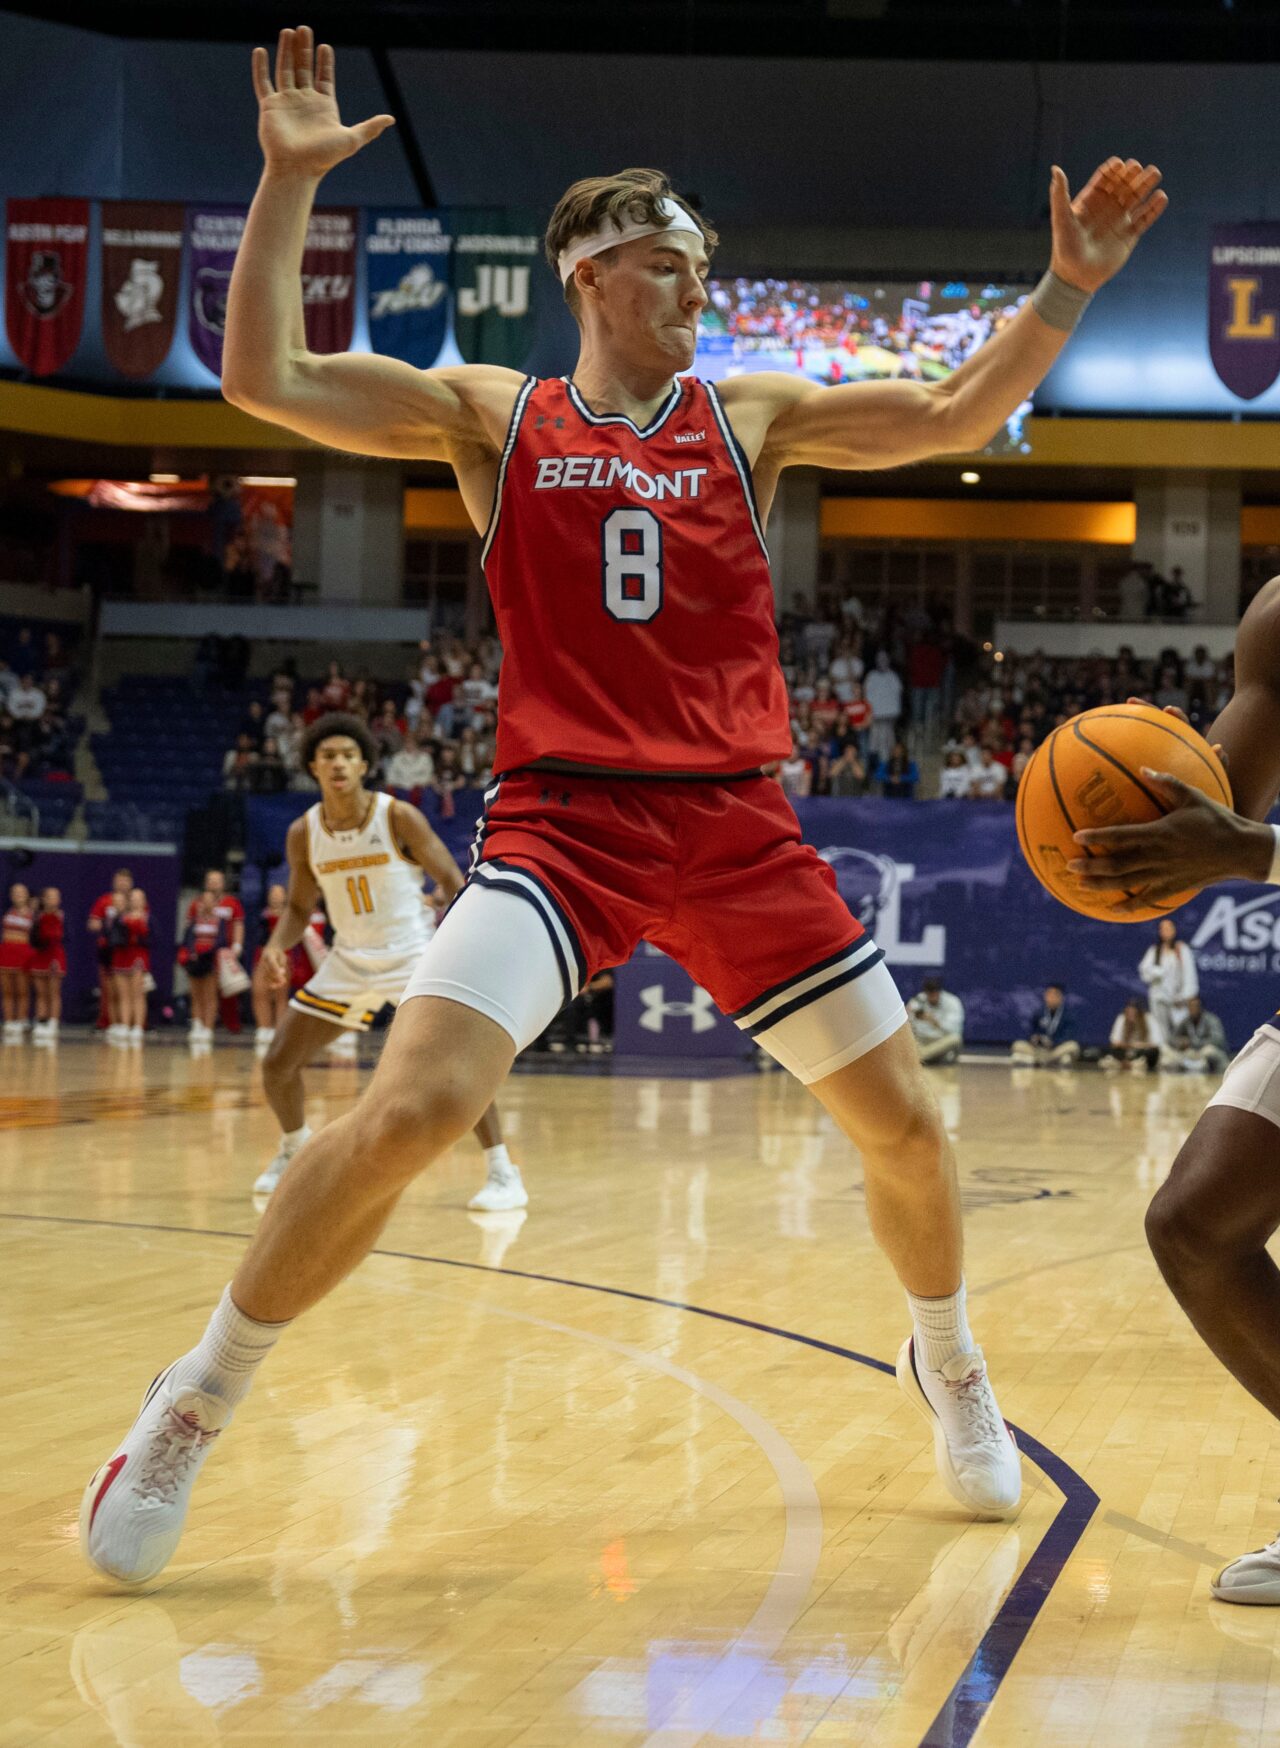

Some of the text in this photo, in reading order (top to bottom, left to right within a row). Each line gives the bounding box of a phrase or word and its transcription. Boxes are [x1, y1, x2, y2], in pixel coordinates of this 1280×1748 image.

[458, 264, 531, 318] JU
[1226, 279, 1276, 341] L
[673, 429, 706, 444] VALLEY
[533, 454, 708, 501] BELMONT
[600, 505, 665, 624] 8
[346, 874, 375, 915] 11
[1196, 950, 1268, 973] ederal
